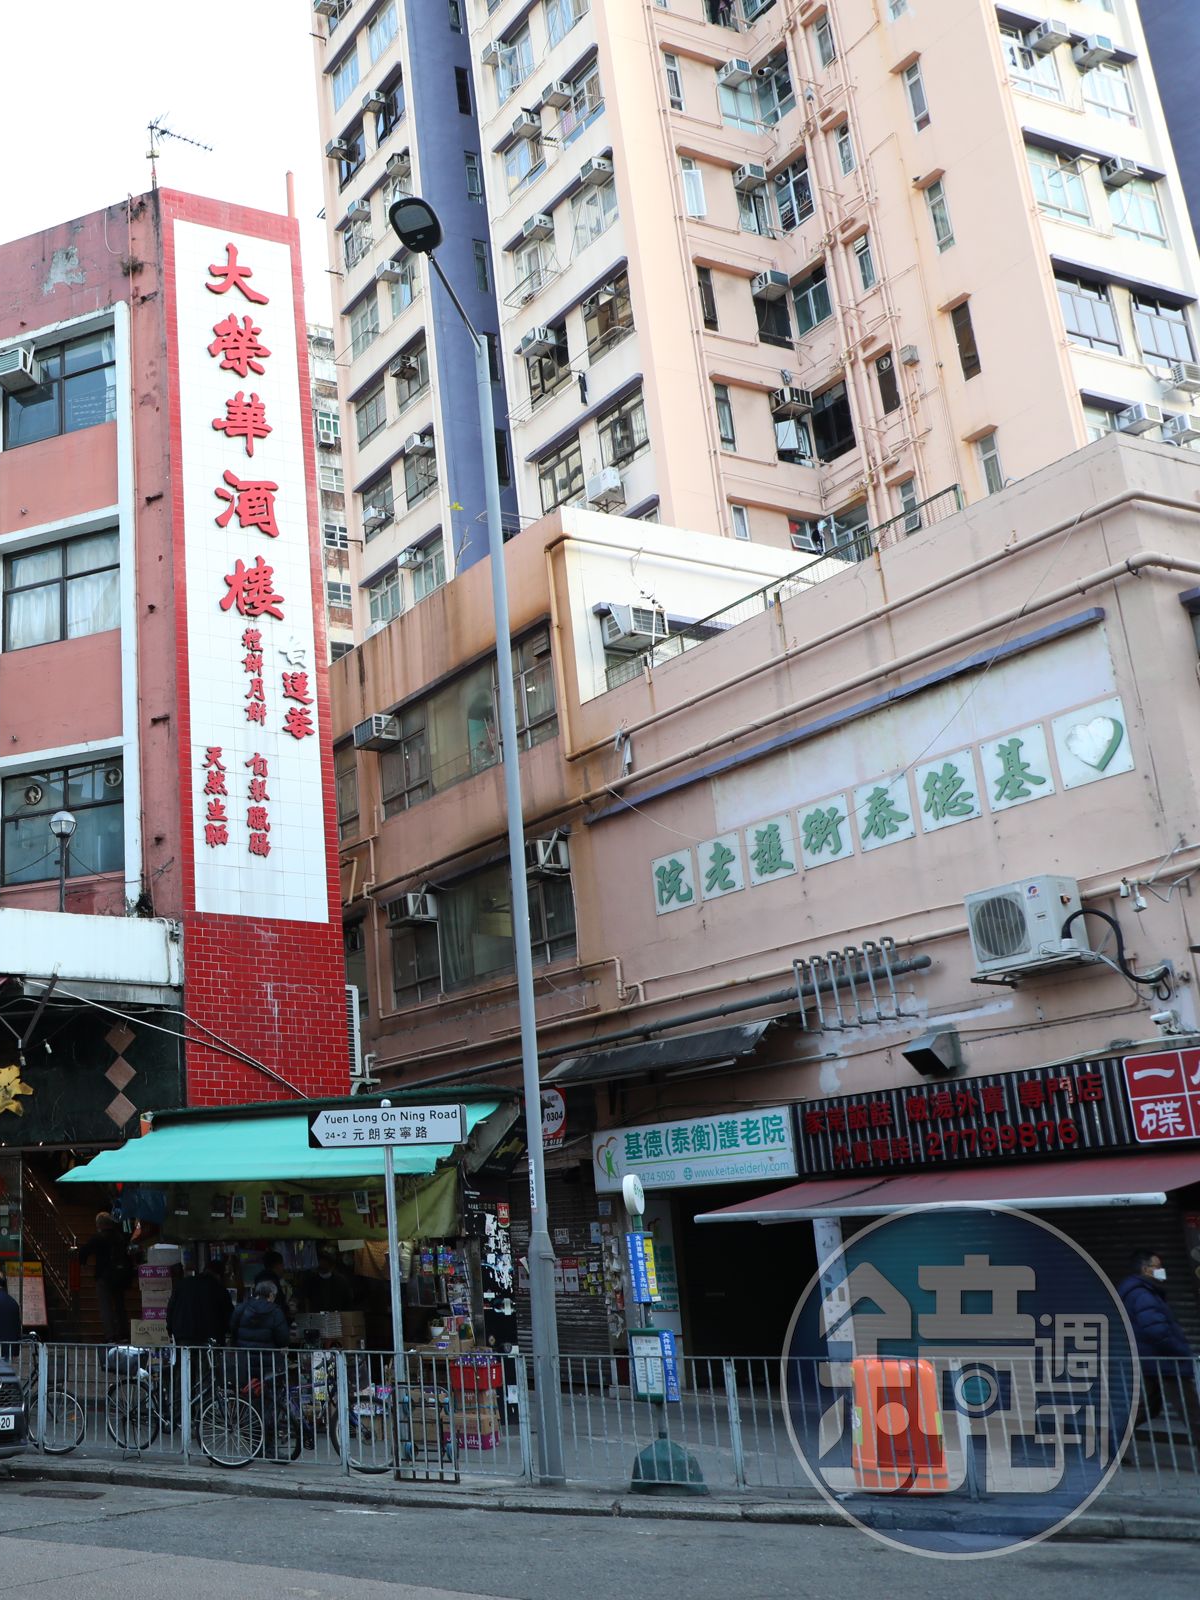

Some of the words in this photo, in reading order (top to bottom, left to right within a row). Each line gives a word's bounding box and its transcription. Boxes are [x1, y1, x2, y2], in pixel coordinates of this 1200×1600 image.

[205, 242, 285, 621] 大榮華酒樓
[202, 746, 229, 848] 天然生晒
[324, 1114, 349, 1124] Yuen
[352, 1113, 377, 1124] Long
[381, 1112, 396, 1122] On
[400, 1110, 425, 1122] Ning
[429, 1109, 458, 1120] Road
[352, 1126, 428, 1141] 元朗安寧路
[624, 1114, 785, 1161] 基德(泰衡)護老院
[926, 1118, 1078, 1156] 27799876
[656, 1170, 676, 1182] 5050
